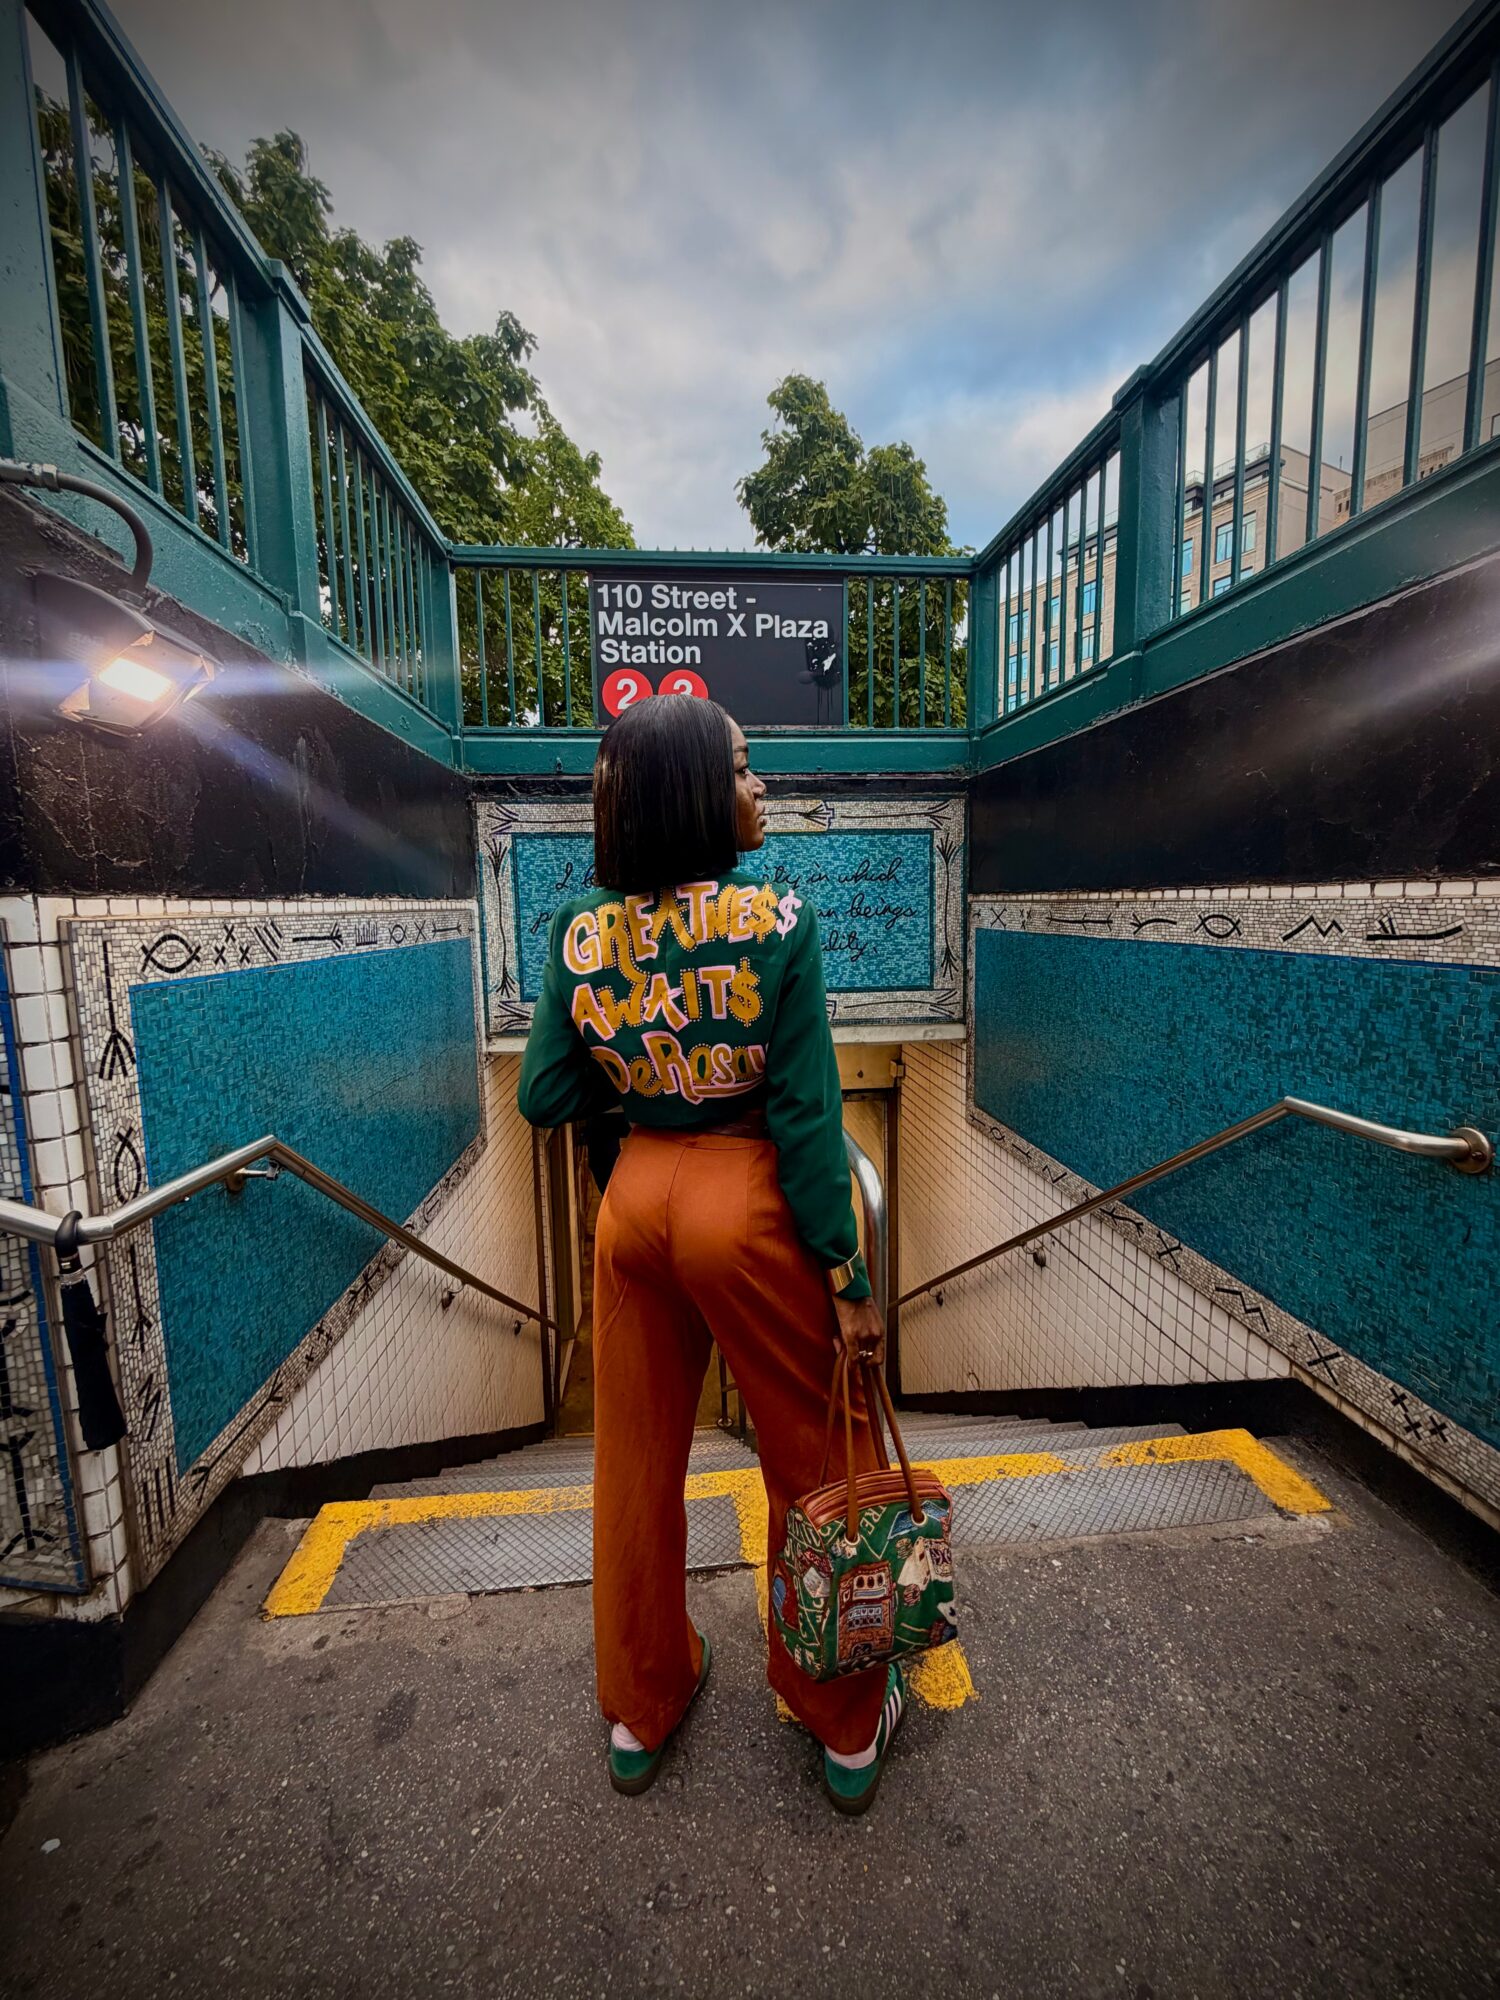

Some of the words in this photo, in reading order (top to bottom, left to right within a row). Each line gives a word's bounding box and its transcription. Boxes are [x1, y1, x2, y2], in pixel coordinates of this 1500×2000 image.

[597, 584, 642, 609] 110
[651, 584, 738, 610] Street
[598, 611, 718, 637] Malcolm
[727, 613, 747, 637] X
[755, 614, 829, 638] Plaza
[600, 639, 701, 664] Station
[616, 678, 638, 709] 2
[839, 857, 902, 884] which
[846, 893, 917, 930] beings
